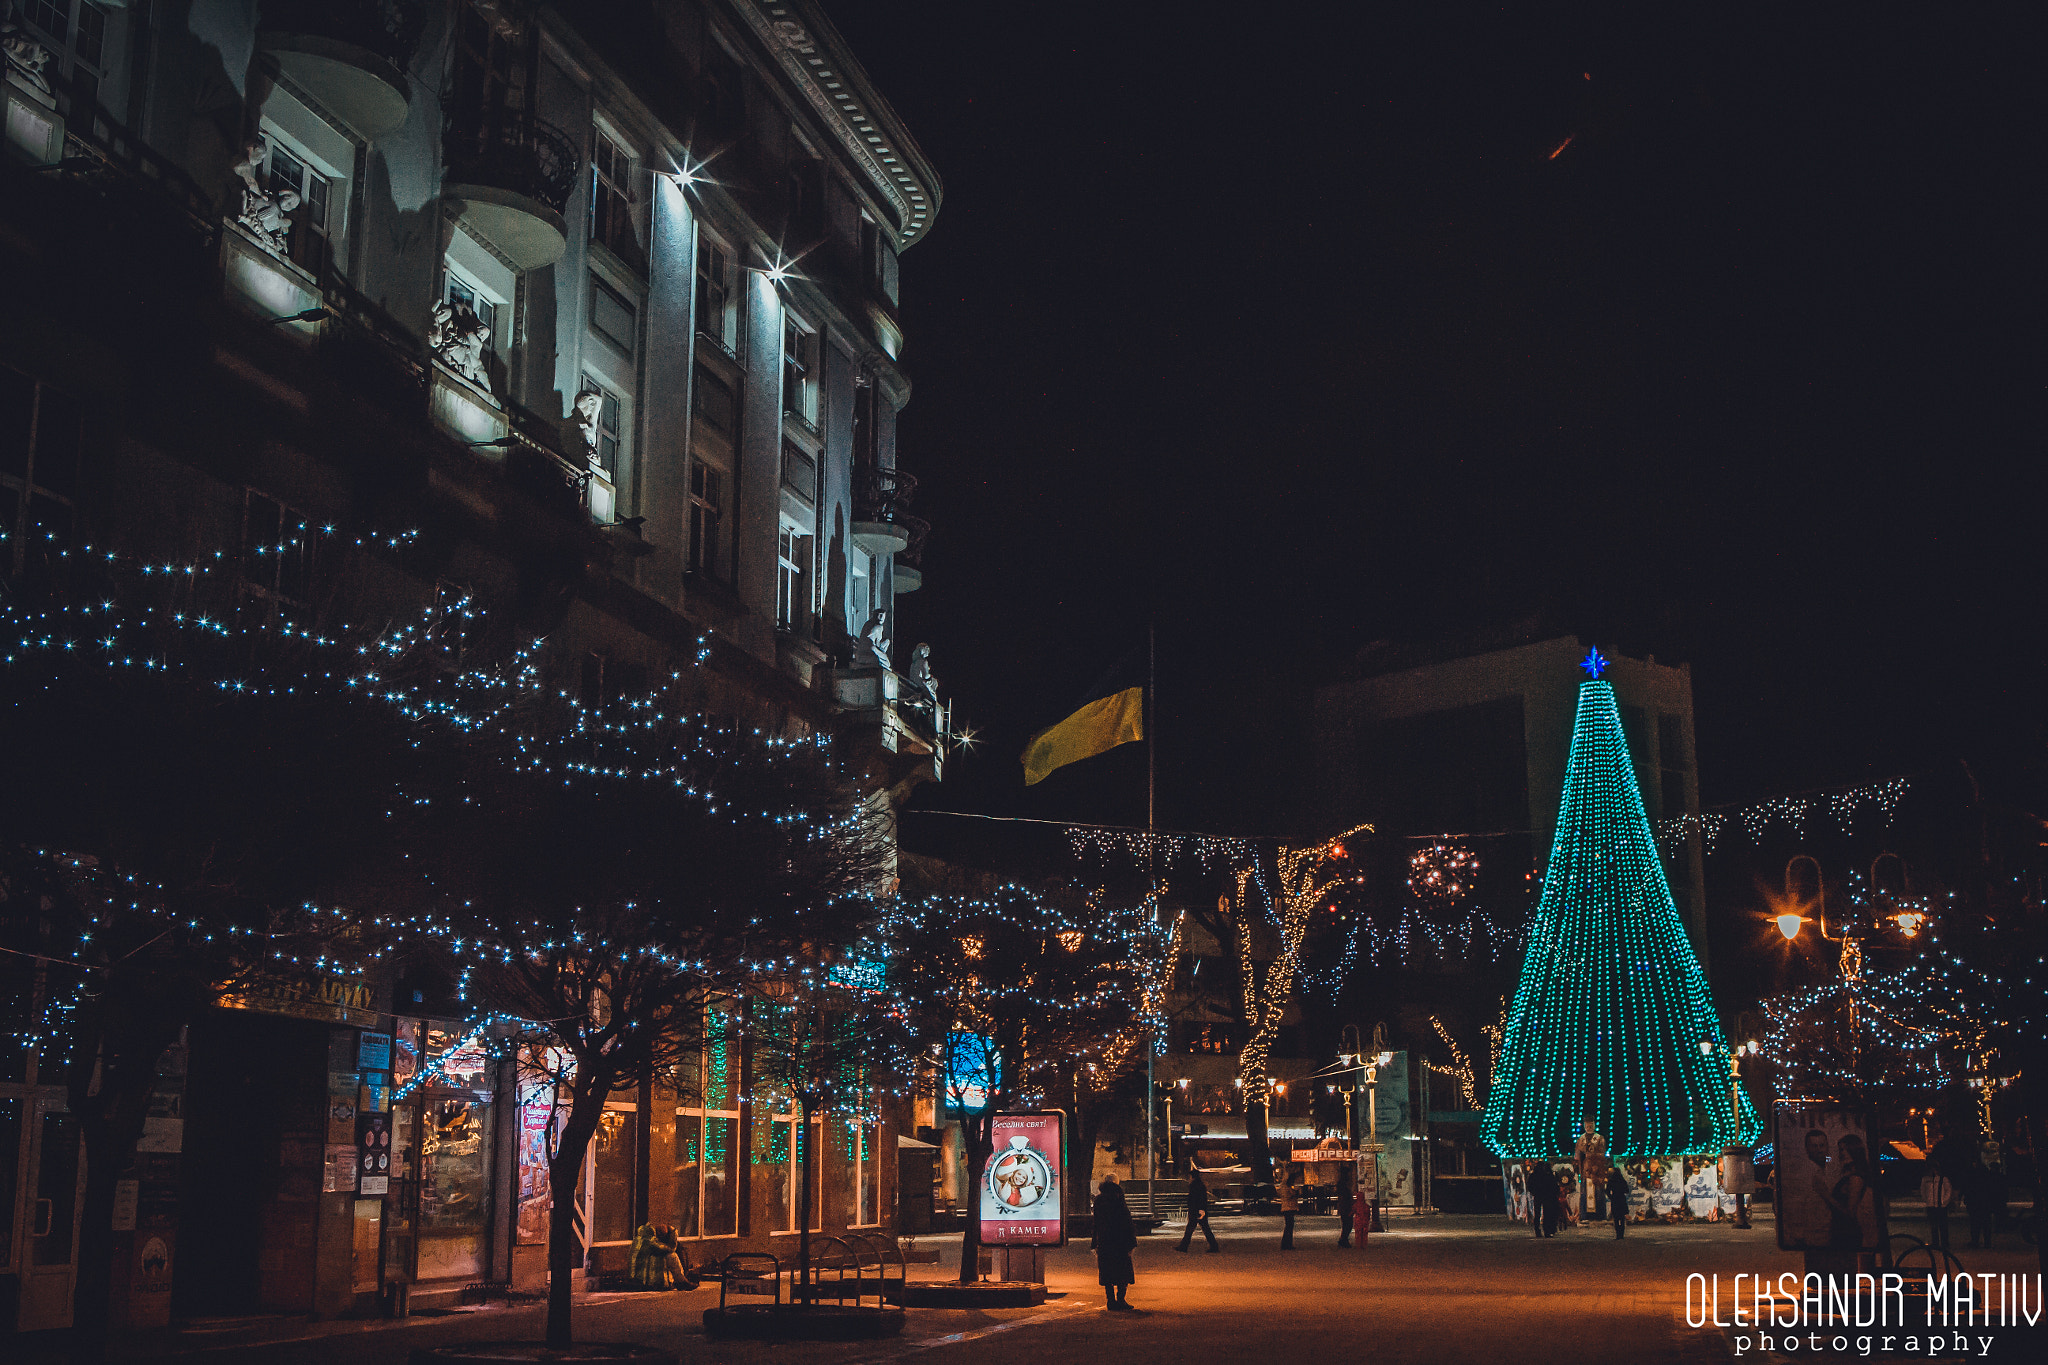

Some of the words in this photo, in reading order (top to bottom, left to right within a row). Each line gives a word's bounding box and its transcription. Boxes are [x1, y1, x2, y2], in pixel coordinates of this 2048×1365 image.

[992, 1119, 1024, 1128] Веселих
[1026, 1119, 1047, 1128] свят!
[1010, 1226, 1047, 1235] КАМЕЯ
